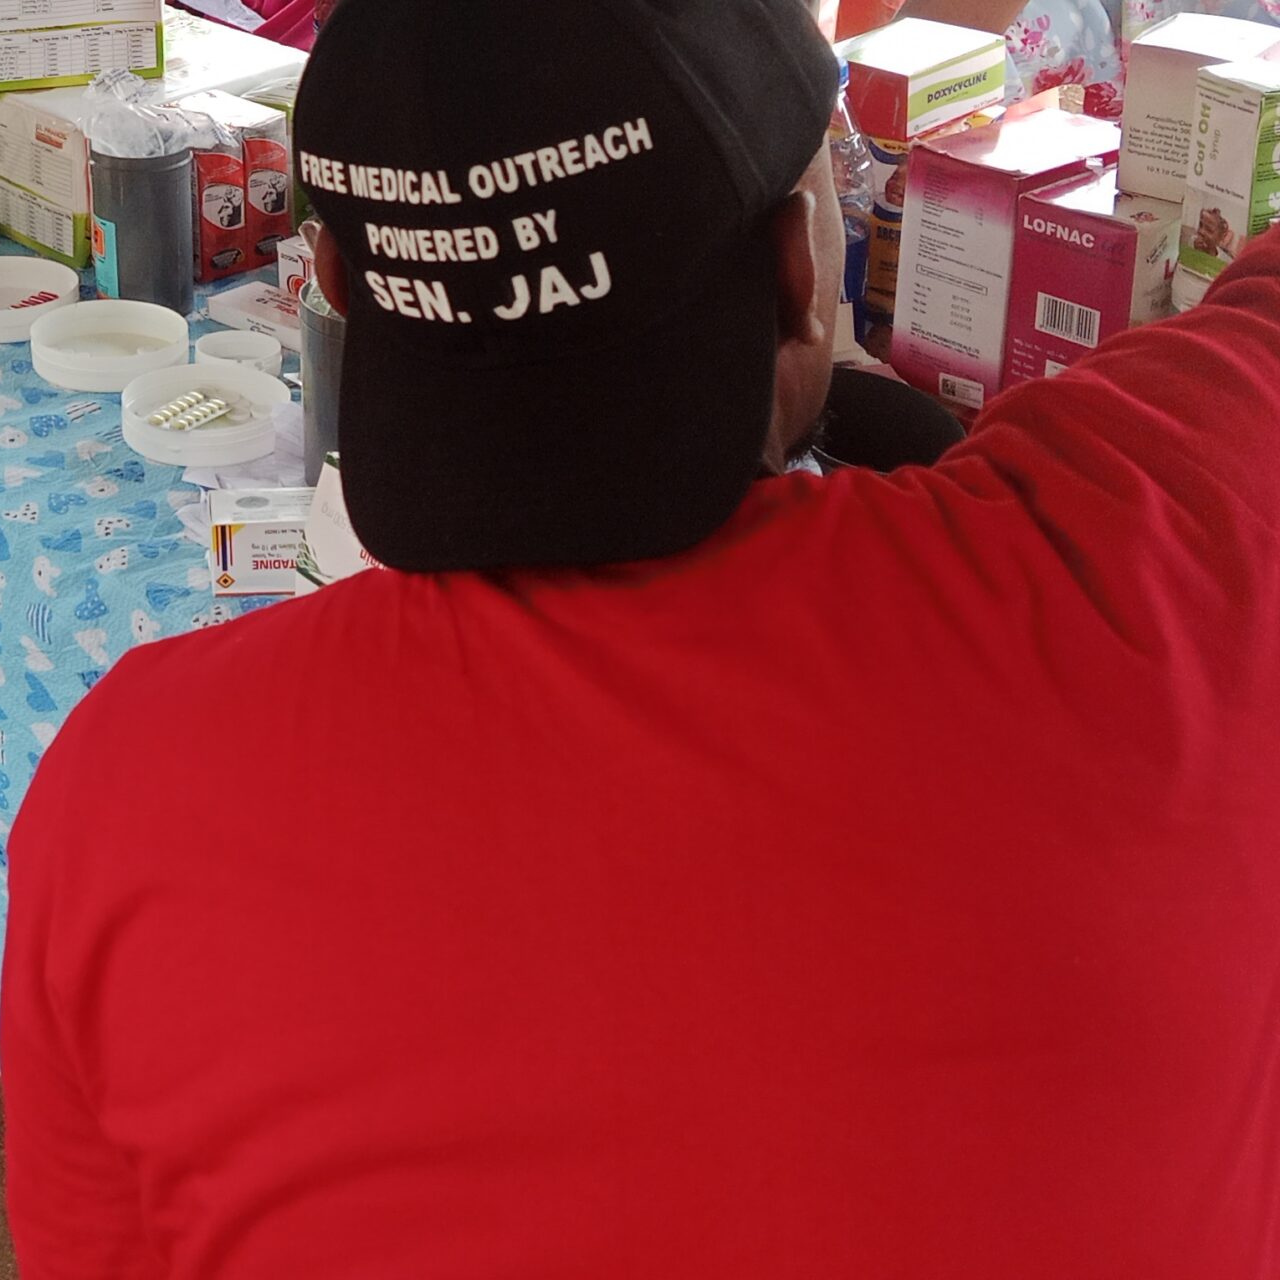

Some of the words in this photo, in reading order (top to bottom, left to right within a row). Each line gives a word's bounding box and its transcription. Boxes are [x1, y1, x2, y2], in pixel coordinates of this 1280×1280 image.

[926, 70, 988, 104] DOXYCYCLINE
[299, 151, 348, 194] FREE
[348, 163, 462, 205] MEDICAL
[468, 117, 654, 199] OUTREACH
[365, 222, 500, 263] POWERED
[511, 209, 559, 252] BY
[1023, 214, 1096, 249] LOFNAC
[365, 270, 472, 324] SEN.
[493, 251, 612, 322] JAJ
[252, 559, 298, 570] TADINE
